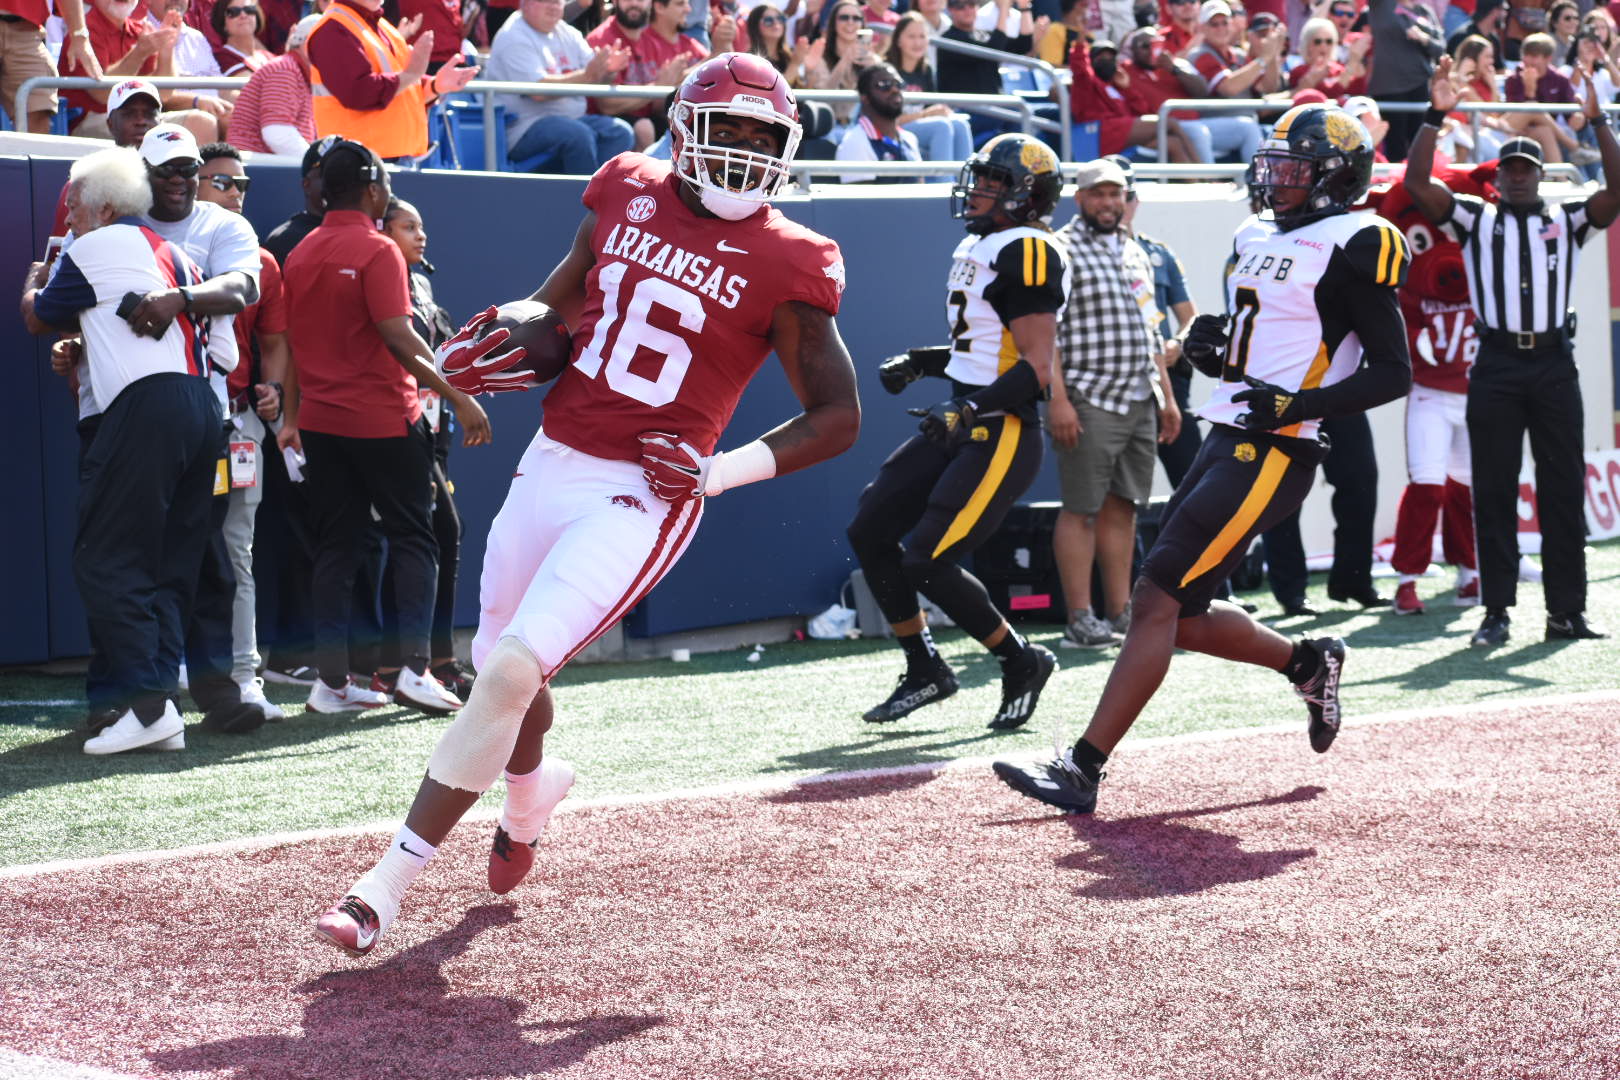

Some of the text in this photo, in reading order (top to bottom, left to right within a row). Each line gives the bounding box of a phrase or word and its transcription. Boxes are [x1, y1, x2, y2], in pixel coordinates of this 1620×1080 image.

[741, 95, 766, 105] HOGS
[628, 197, 654, 220] SEC
[602, 223, 748, 309] ARKANSAS
[572, 261, 707, 408] 16
